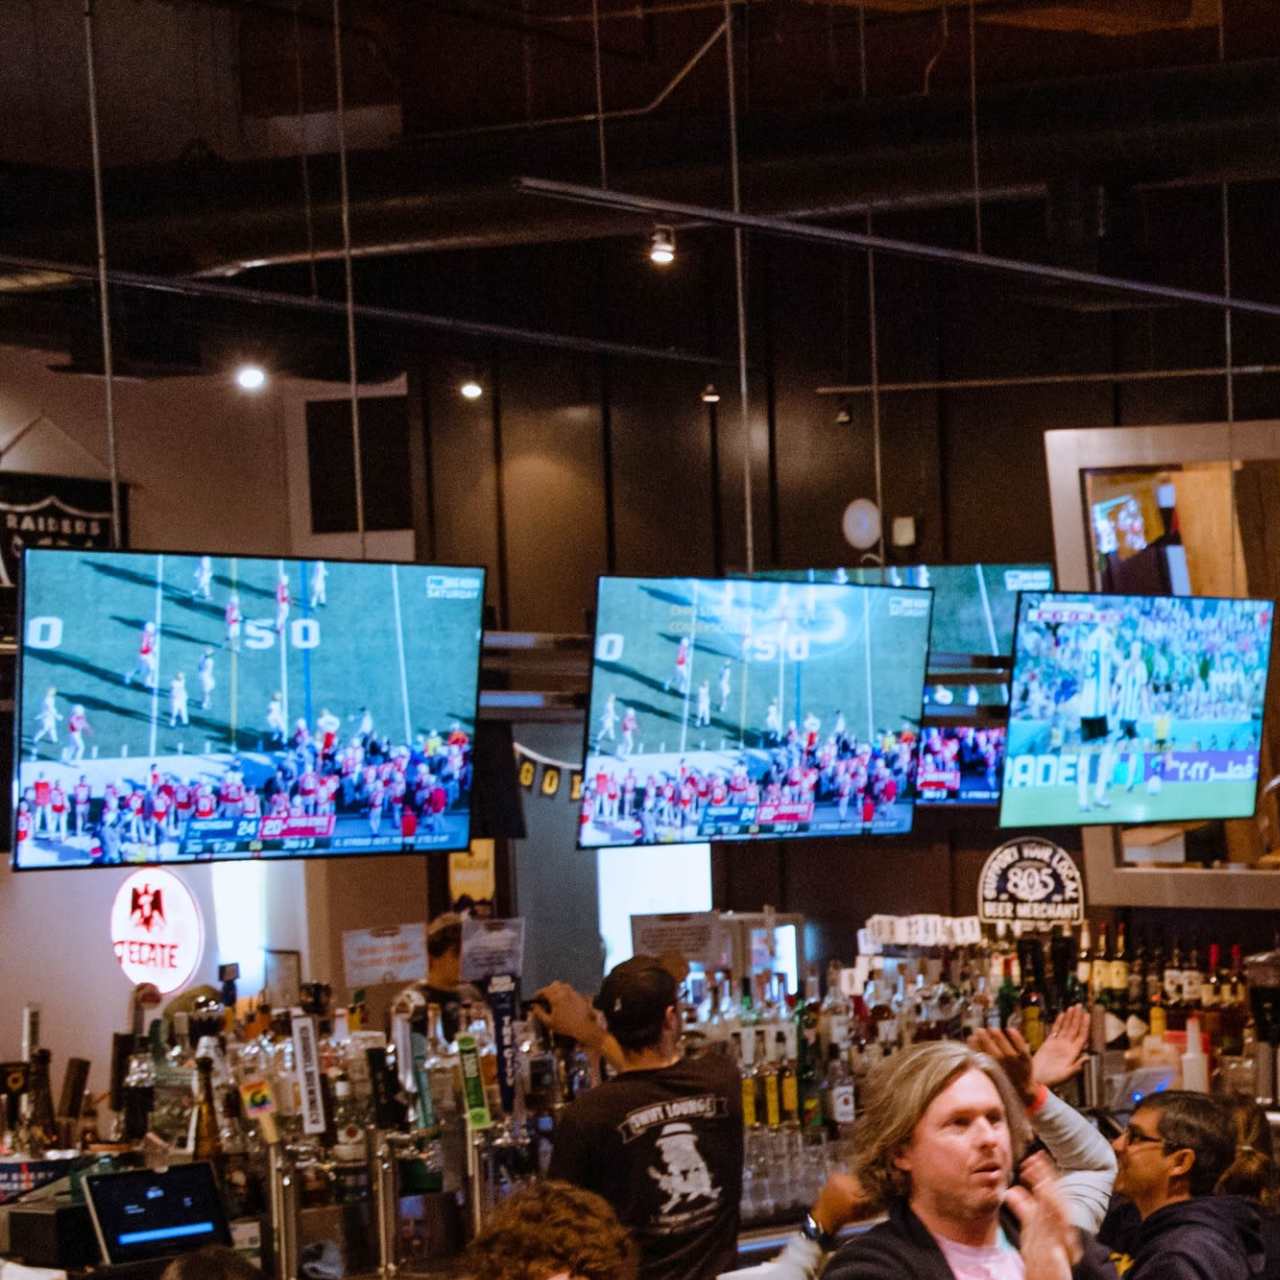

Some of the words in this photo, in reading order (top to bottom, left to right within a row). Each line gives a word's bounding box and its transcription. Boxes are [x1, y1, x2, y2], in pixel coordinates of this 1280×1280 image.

[6, 513, 100, 536] RAIDERS
[1006, 867, 1056, 900] 805
[984, 901, 1014, 918] BEER
[1016, 902, 1080, 919] MERCHANT
[113, 940, 180, 969] TECATE
